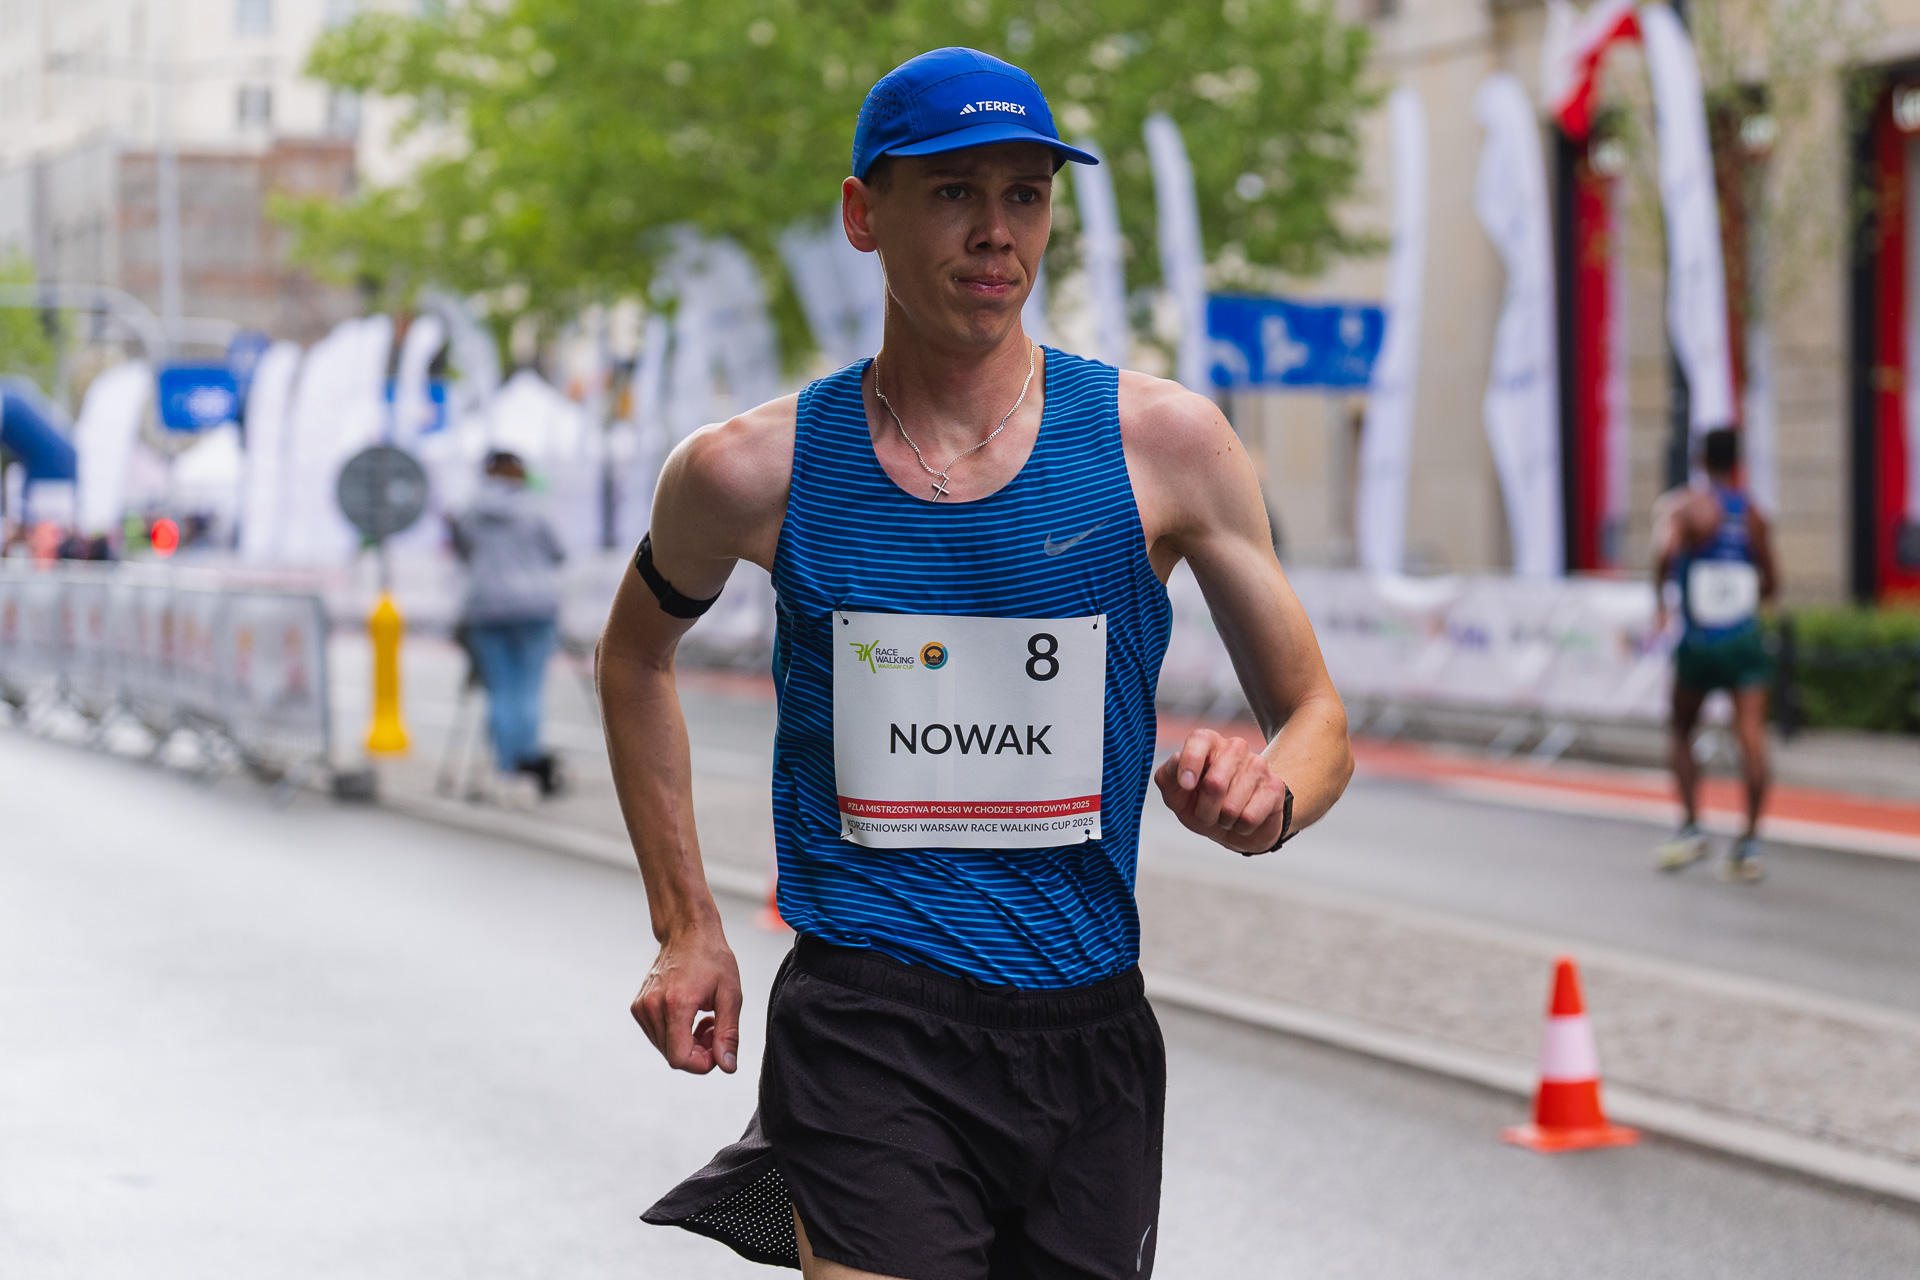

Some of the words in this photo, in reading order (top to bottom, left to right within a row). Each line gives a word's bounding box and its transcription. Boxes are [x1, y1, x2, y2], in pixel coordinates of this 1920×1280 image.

[976, 101, 1026, 116] TERREX
[875, 648, 898, 656] RACE
[1025, 633, 1060, 682] 8
[875, 656, 915, 664] WALKING
[890, 722, 1053, 755] NOWAK
[847, 802, 865, 812] PZLA
[865, 805, 929, 814] MISTRZOSTWA
[930, 806, 961, 814] POLSKI
[974, 806, 1014, 814] CHODZIE
[1015, 803, 1071, 814] SPORTOWYM
[1071, 800, 1090, 810] 2025
[847, 818, 918, 833] KORZENIOWSKI
[920, 823, 969, 832] WARSAW
[971, 823, 998, 832] RACE
[1000, 822, 1050, 832] WALKING
[1051, 820, 1071, 831] CUP
[1072, 816, 1094, 828] 2025
